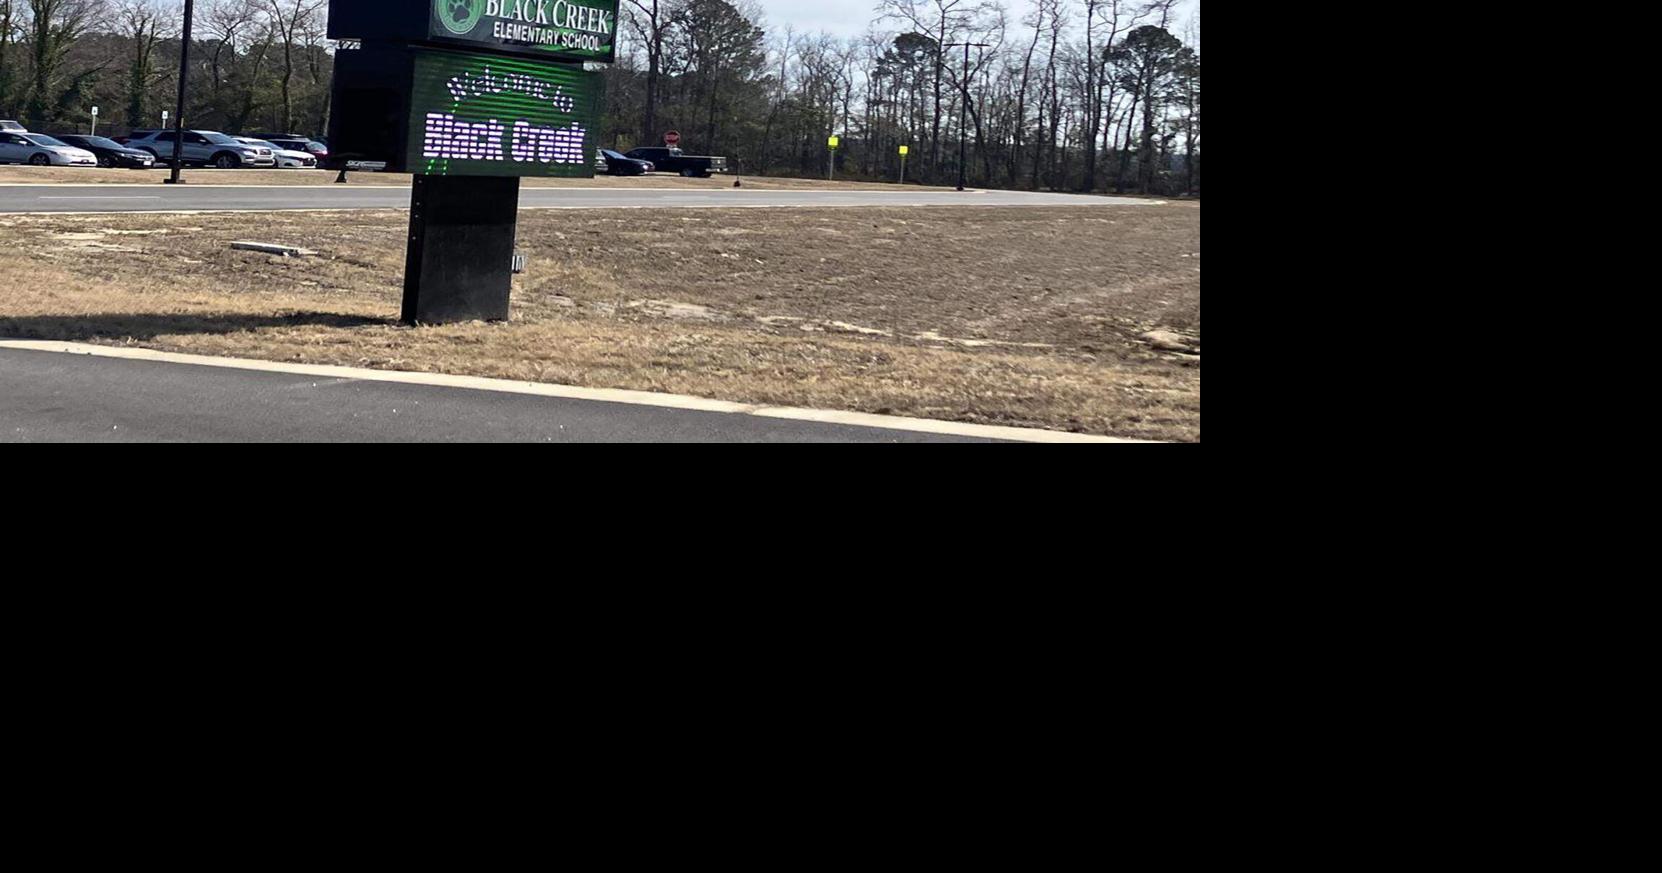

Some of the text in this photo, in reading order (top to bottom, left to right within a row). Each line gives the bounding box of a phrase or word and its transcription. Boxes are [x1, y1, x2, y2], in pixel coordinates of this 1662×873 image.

[485, 0, 549, 24] BLACK
[552, 0, 612, 34] CREEK
[493, 21, 559, 45] ELEMENTARY
[561, 33, 600, 51] SCHOOL
[424, 113, 586, 164] Black Creek
